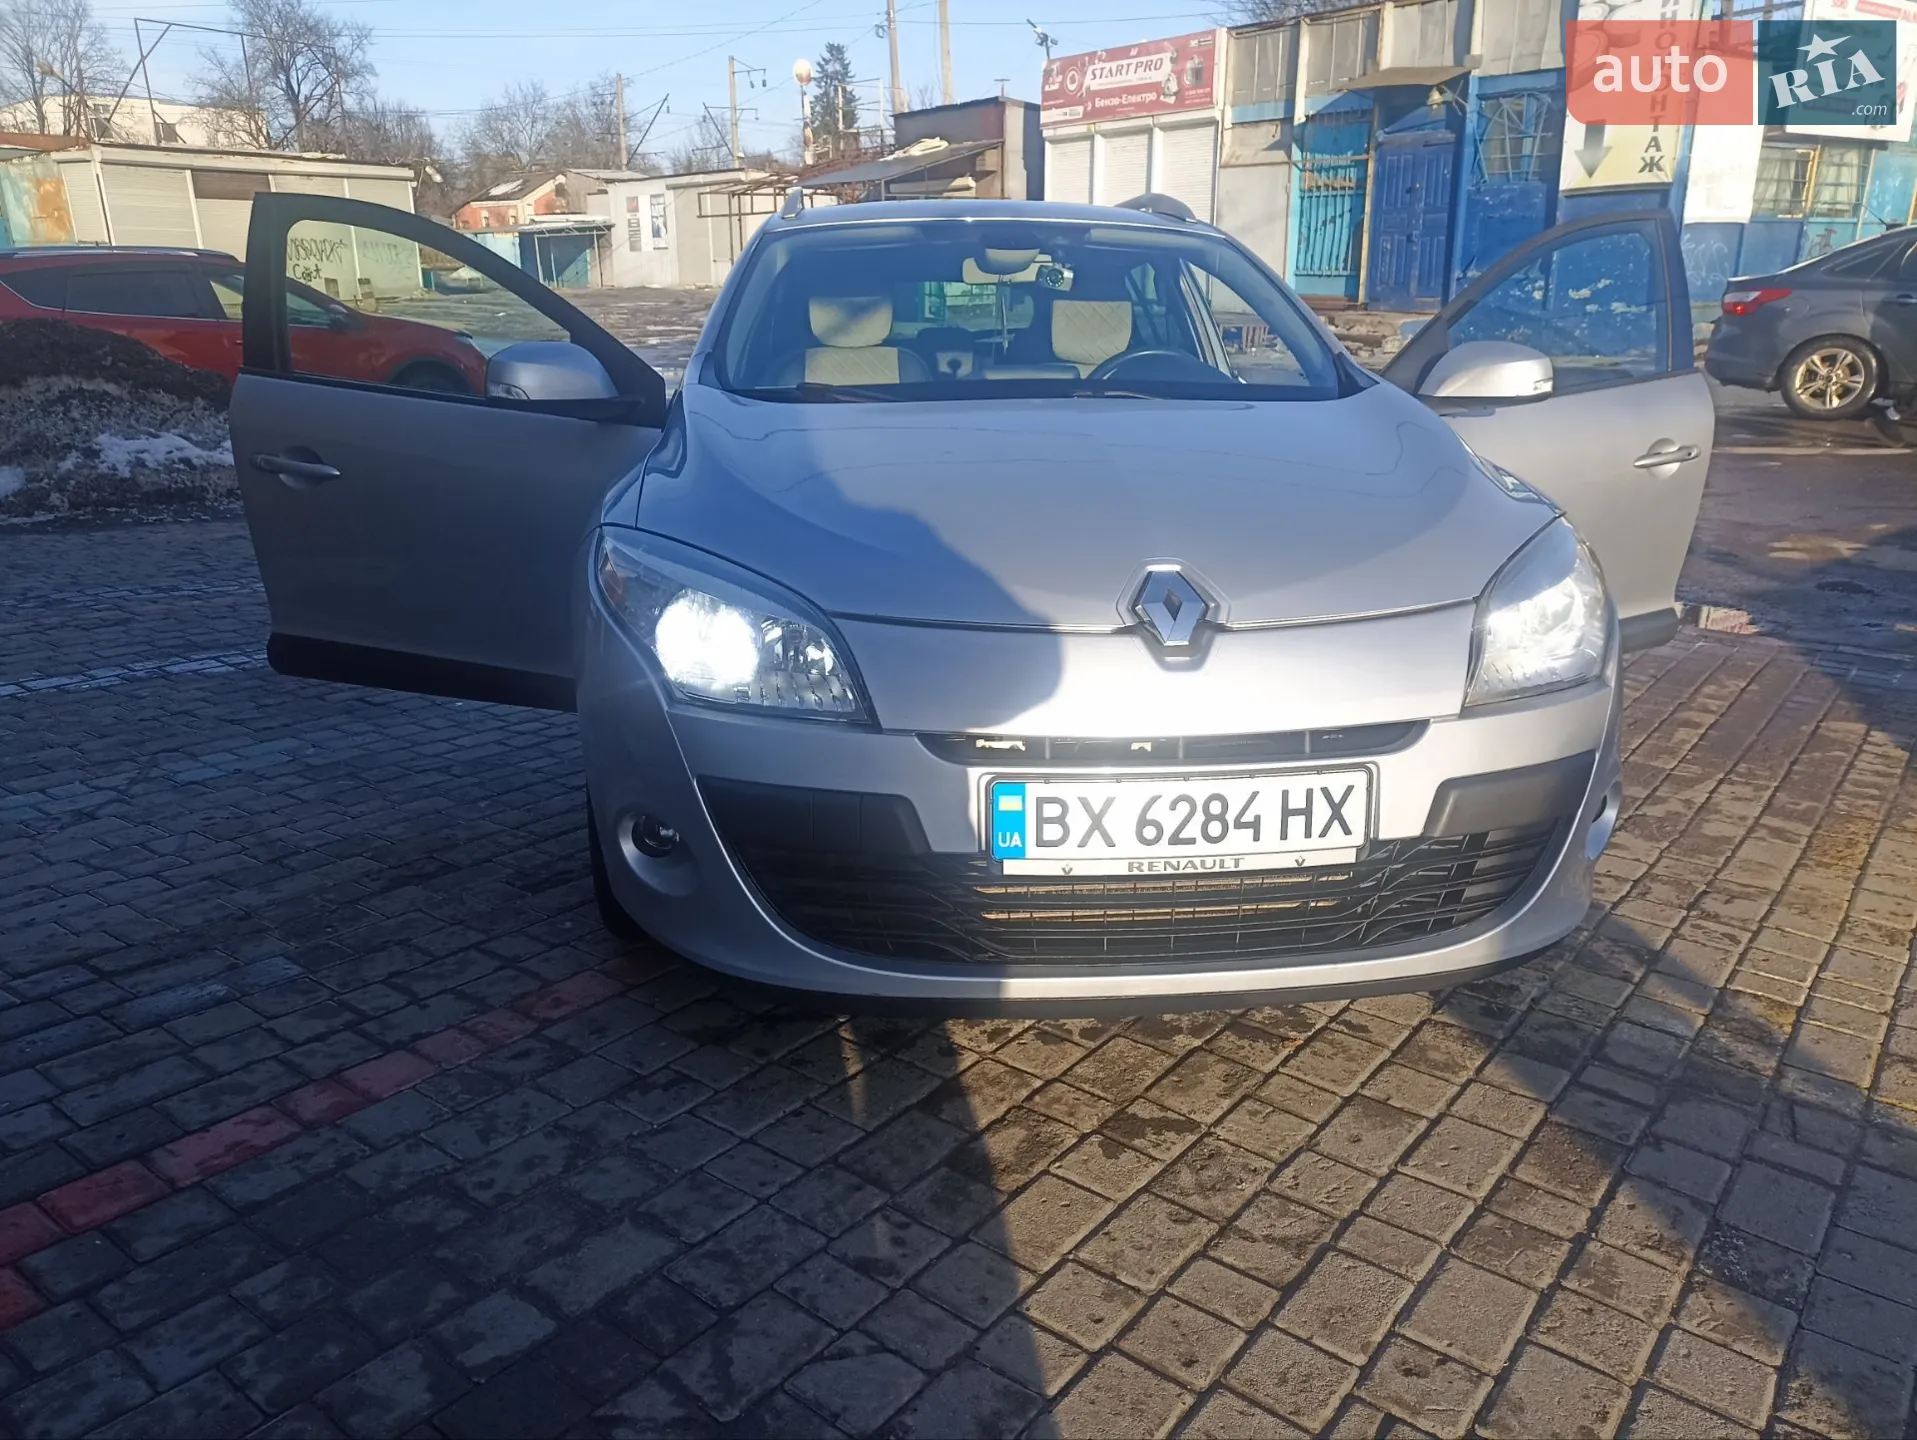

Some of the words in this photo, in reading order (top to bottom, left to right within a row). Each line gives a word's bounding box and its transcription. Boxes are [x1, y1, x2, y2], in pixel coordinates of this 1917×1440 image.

[1035, 796, 1116, 848] BX
[1135, 791, 1261, 846] 6284
[1280, 784, 1355, 840] HX
[998, 831, 1022, 848] UA
[1127, 857, 1245, 873] RENAULT
